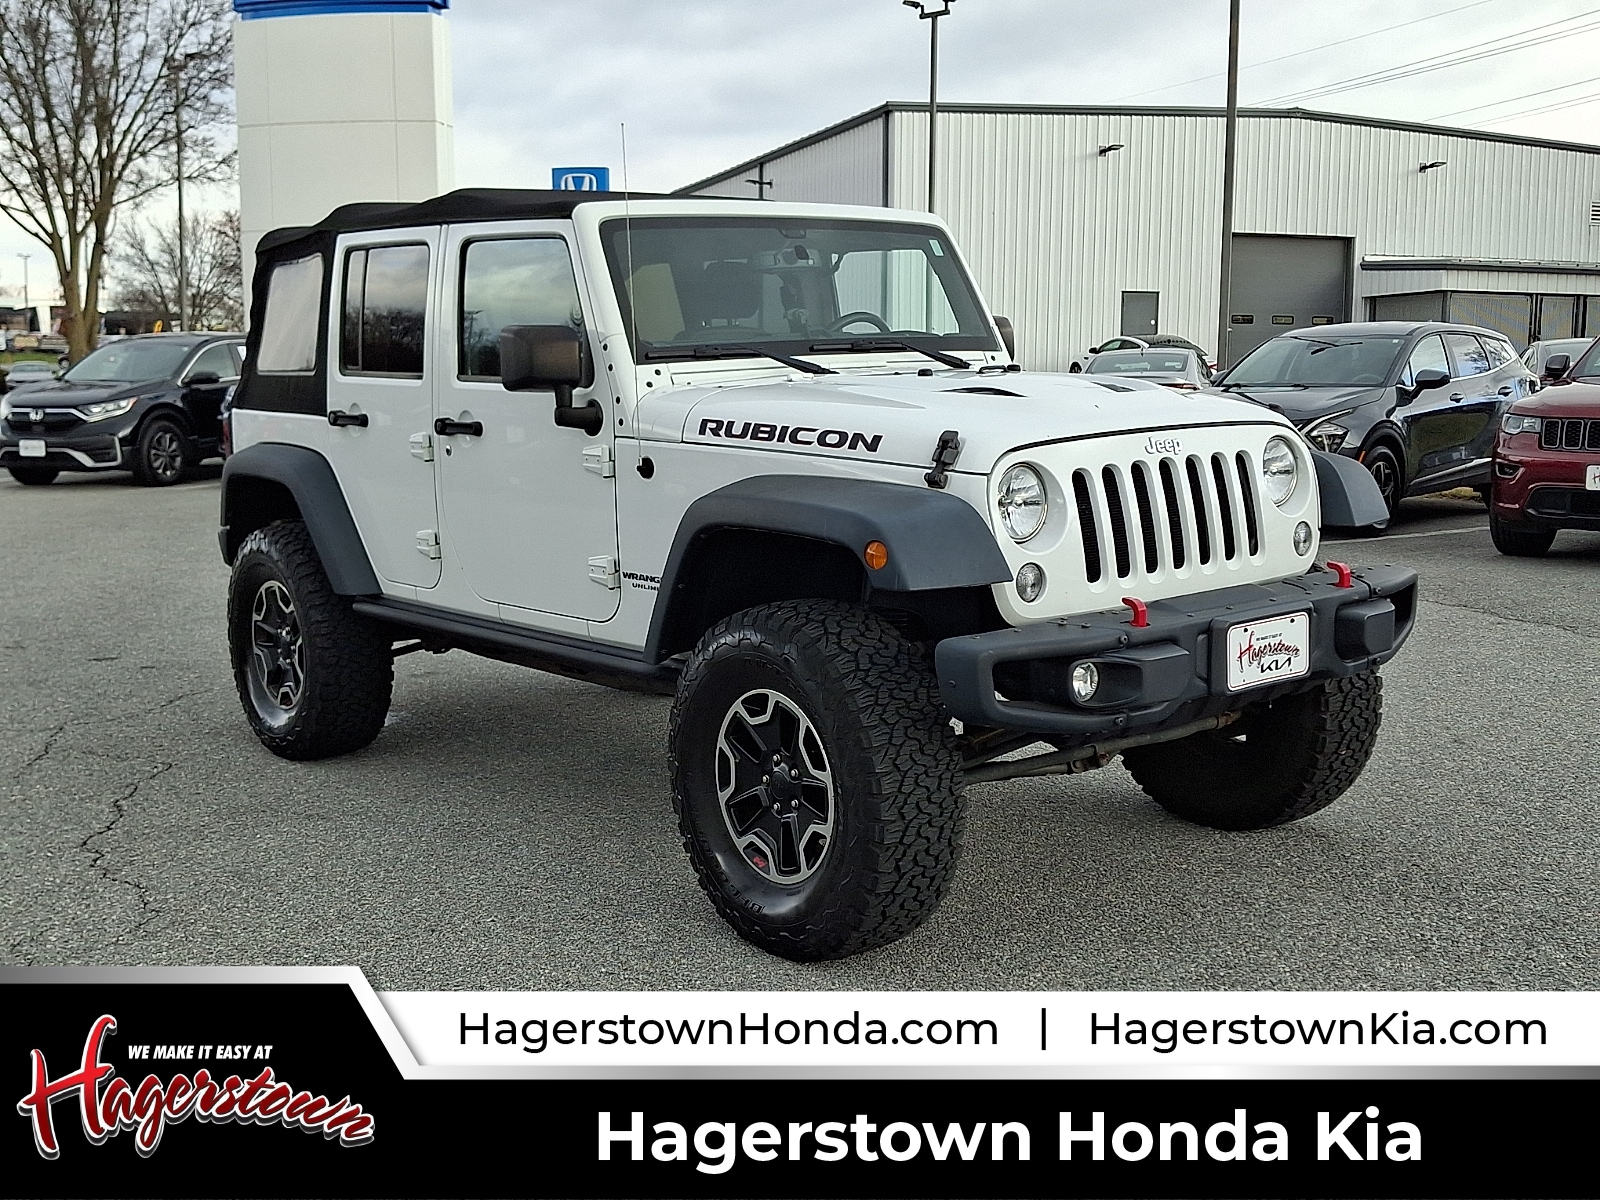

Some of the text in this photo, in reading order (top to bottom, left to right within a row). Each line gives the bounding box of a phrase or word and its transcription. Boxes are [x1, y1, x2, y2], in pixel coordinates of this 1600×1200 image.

[698, 418, 884, 453] RUBICON
[1144, 435, 1183, 456] Jeep
[1236, 630, 1300, 674] Hagerstown
